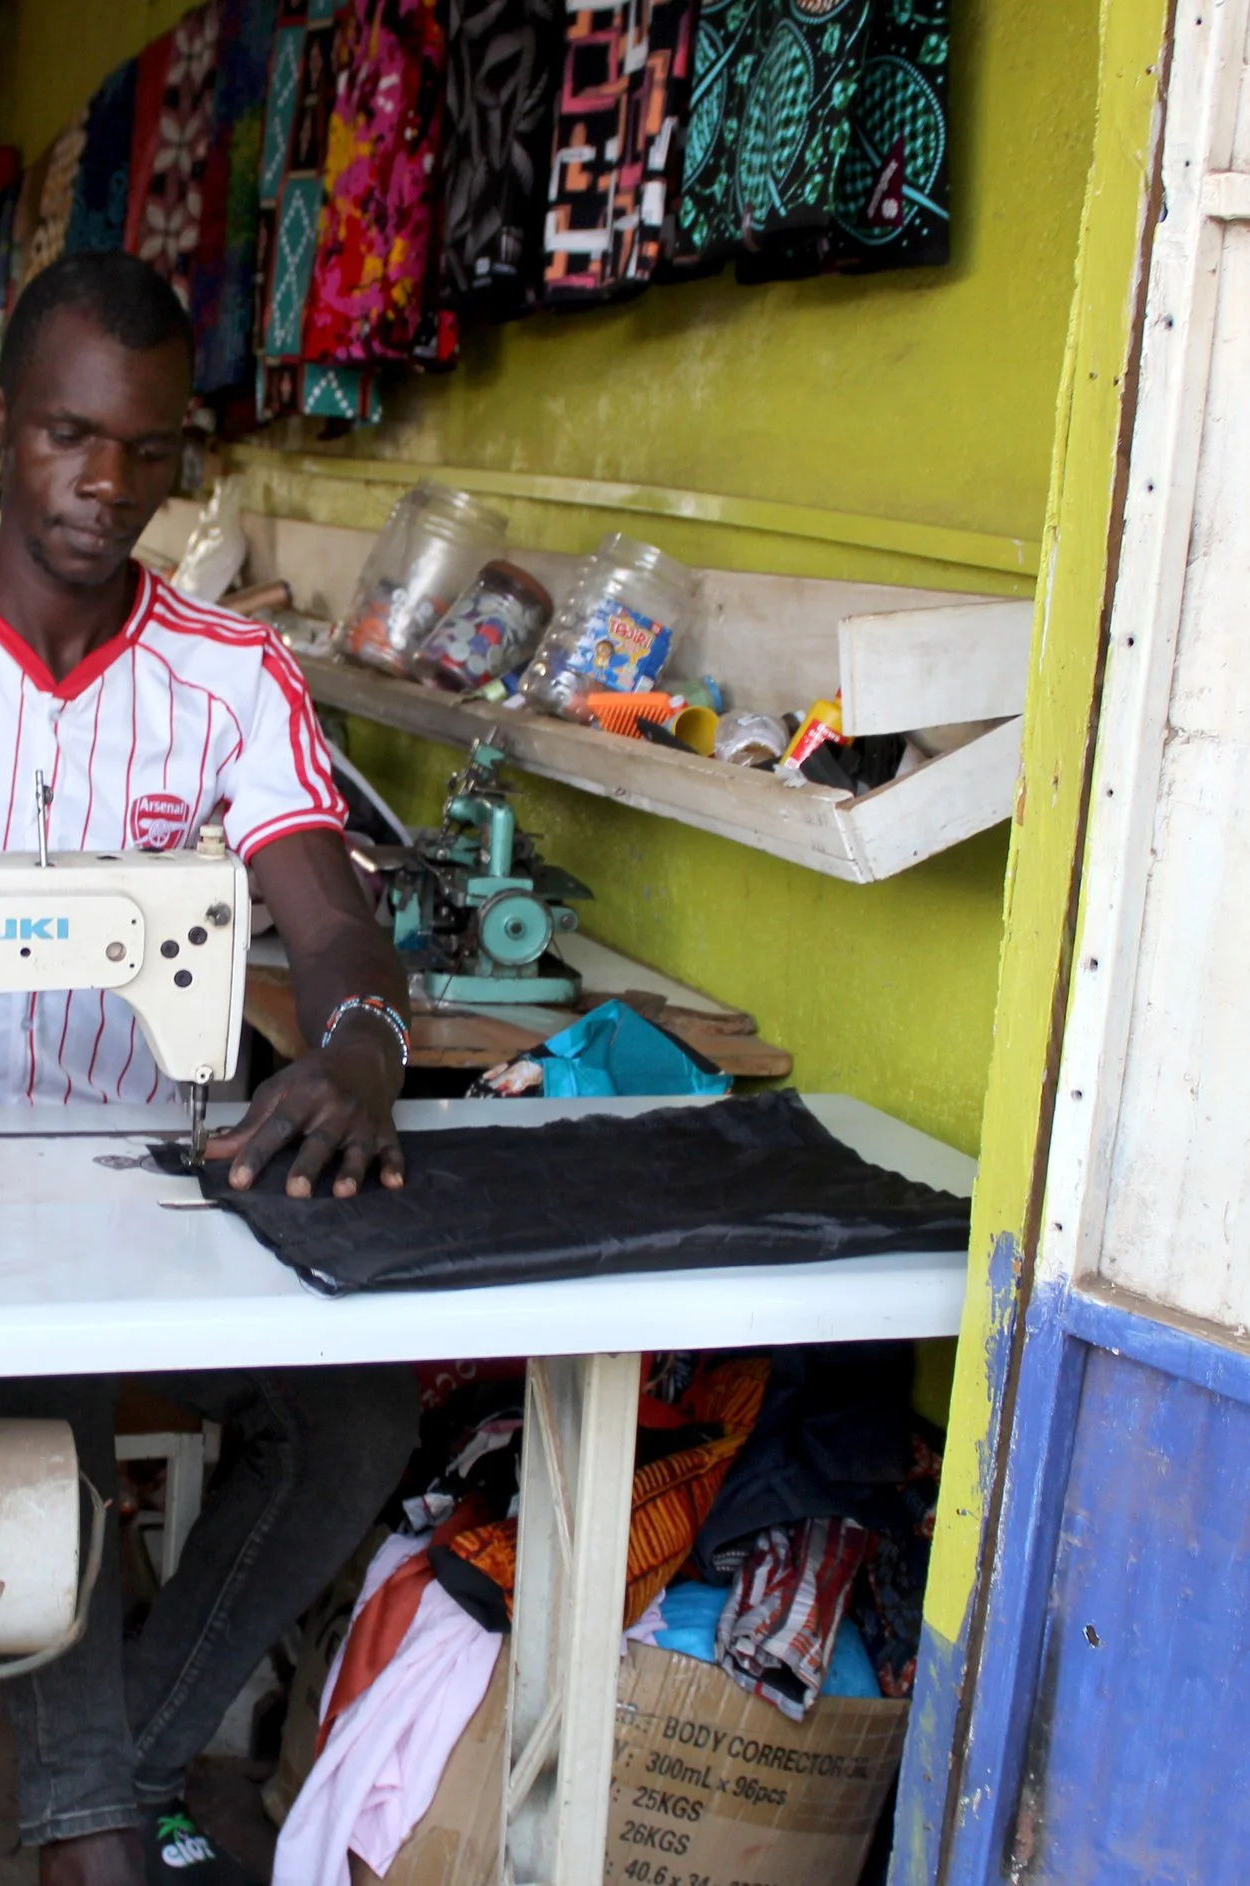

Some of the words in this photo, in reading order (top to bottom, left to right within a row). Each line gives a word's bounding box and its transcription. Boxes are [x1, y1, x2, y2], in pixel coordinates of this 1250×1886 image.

[139, 797, 185, 817] Arsenal
[662, 1716, 727, 1752] BODY
[727, 1735, 845, 1777] CORRECTOR
[645, 1752, 711, 1789] 300mL
[732, 1775, 787, 1806] 96pcs
[632, 1786, 704, 1822] 25KGS
[619, 1820, 691, 1856] 26KGS
[624, 1859, 669, 1886] 40.6
